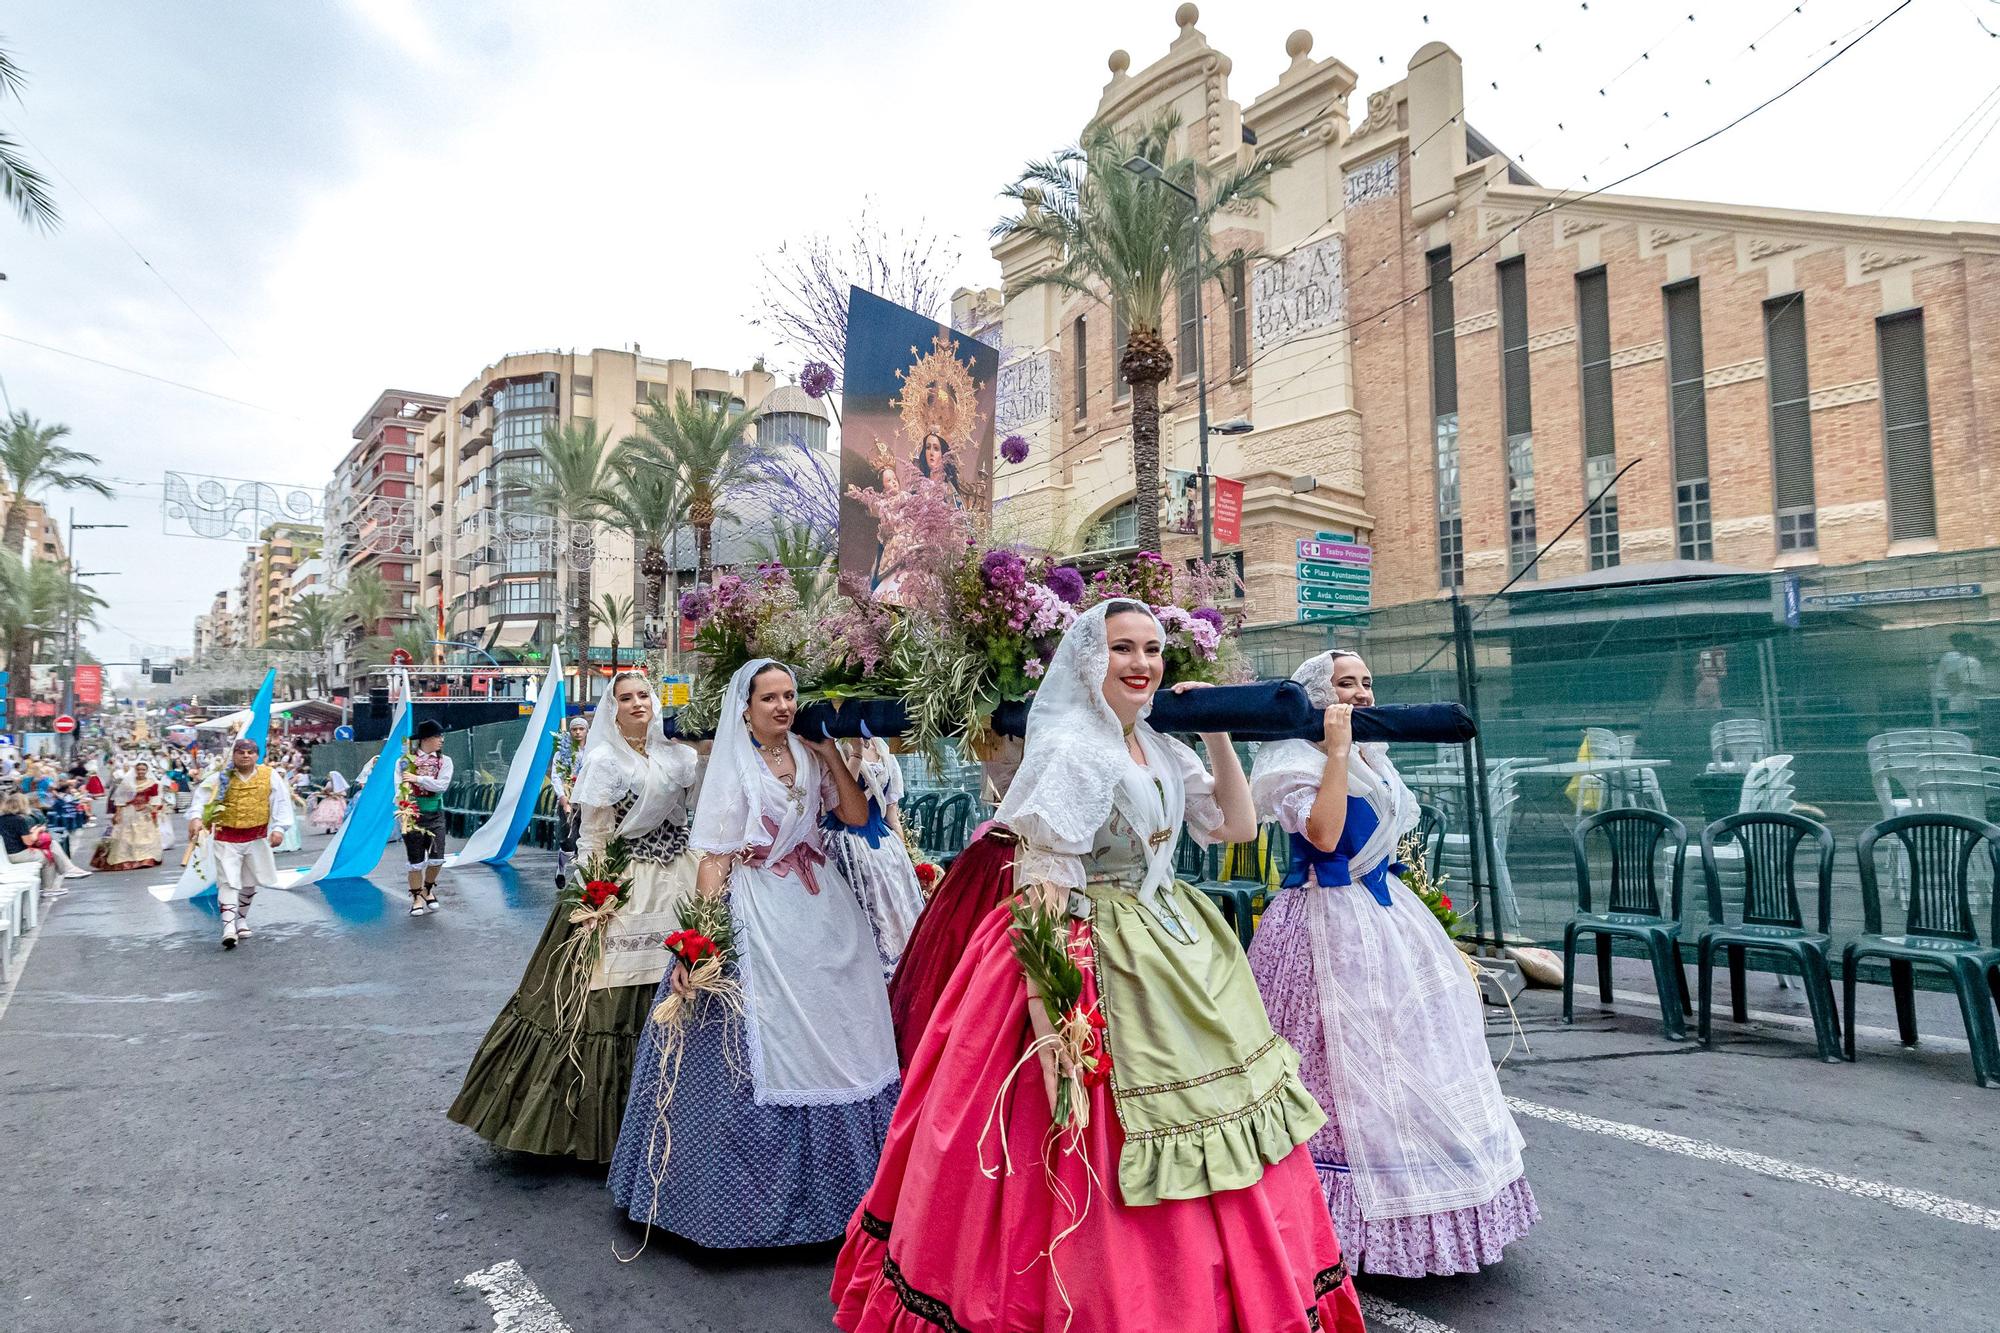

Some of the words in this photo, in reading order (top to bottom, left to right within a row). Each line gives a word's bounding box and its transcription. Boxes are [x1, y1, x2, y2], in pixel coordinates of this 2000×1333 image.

[1262, 259, 1296, 300] DE
[1257, 281, 1336, 338] BASTOS
[1327, 548, 1343, 556] Teatro
[1345, 549, 1370, 560] Principal
[1314, 569, 1330, 577] Plaza
[1332, 570, 1370, 580] Ayuntamiento
[1334, 592, 1369, 602] Constitución
